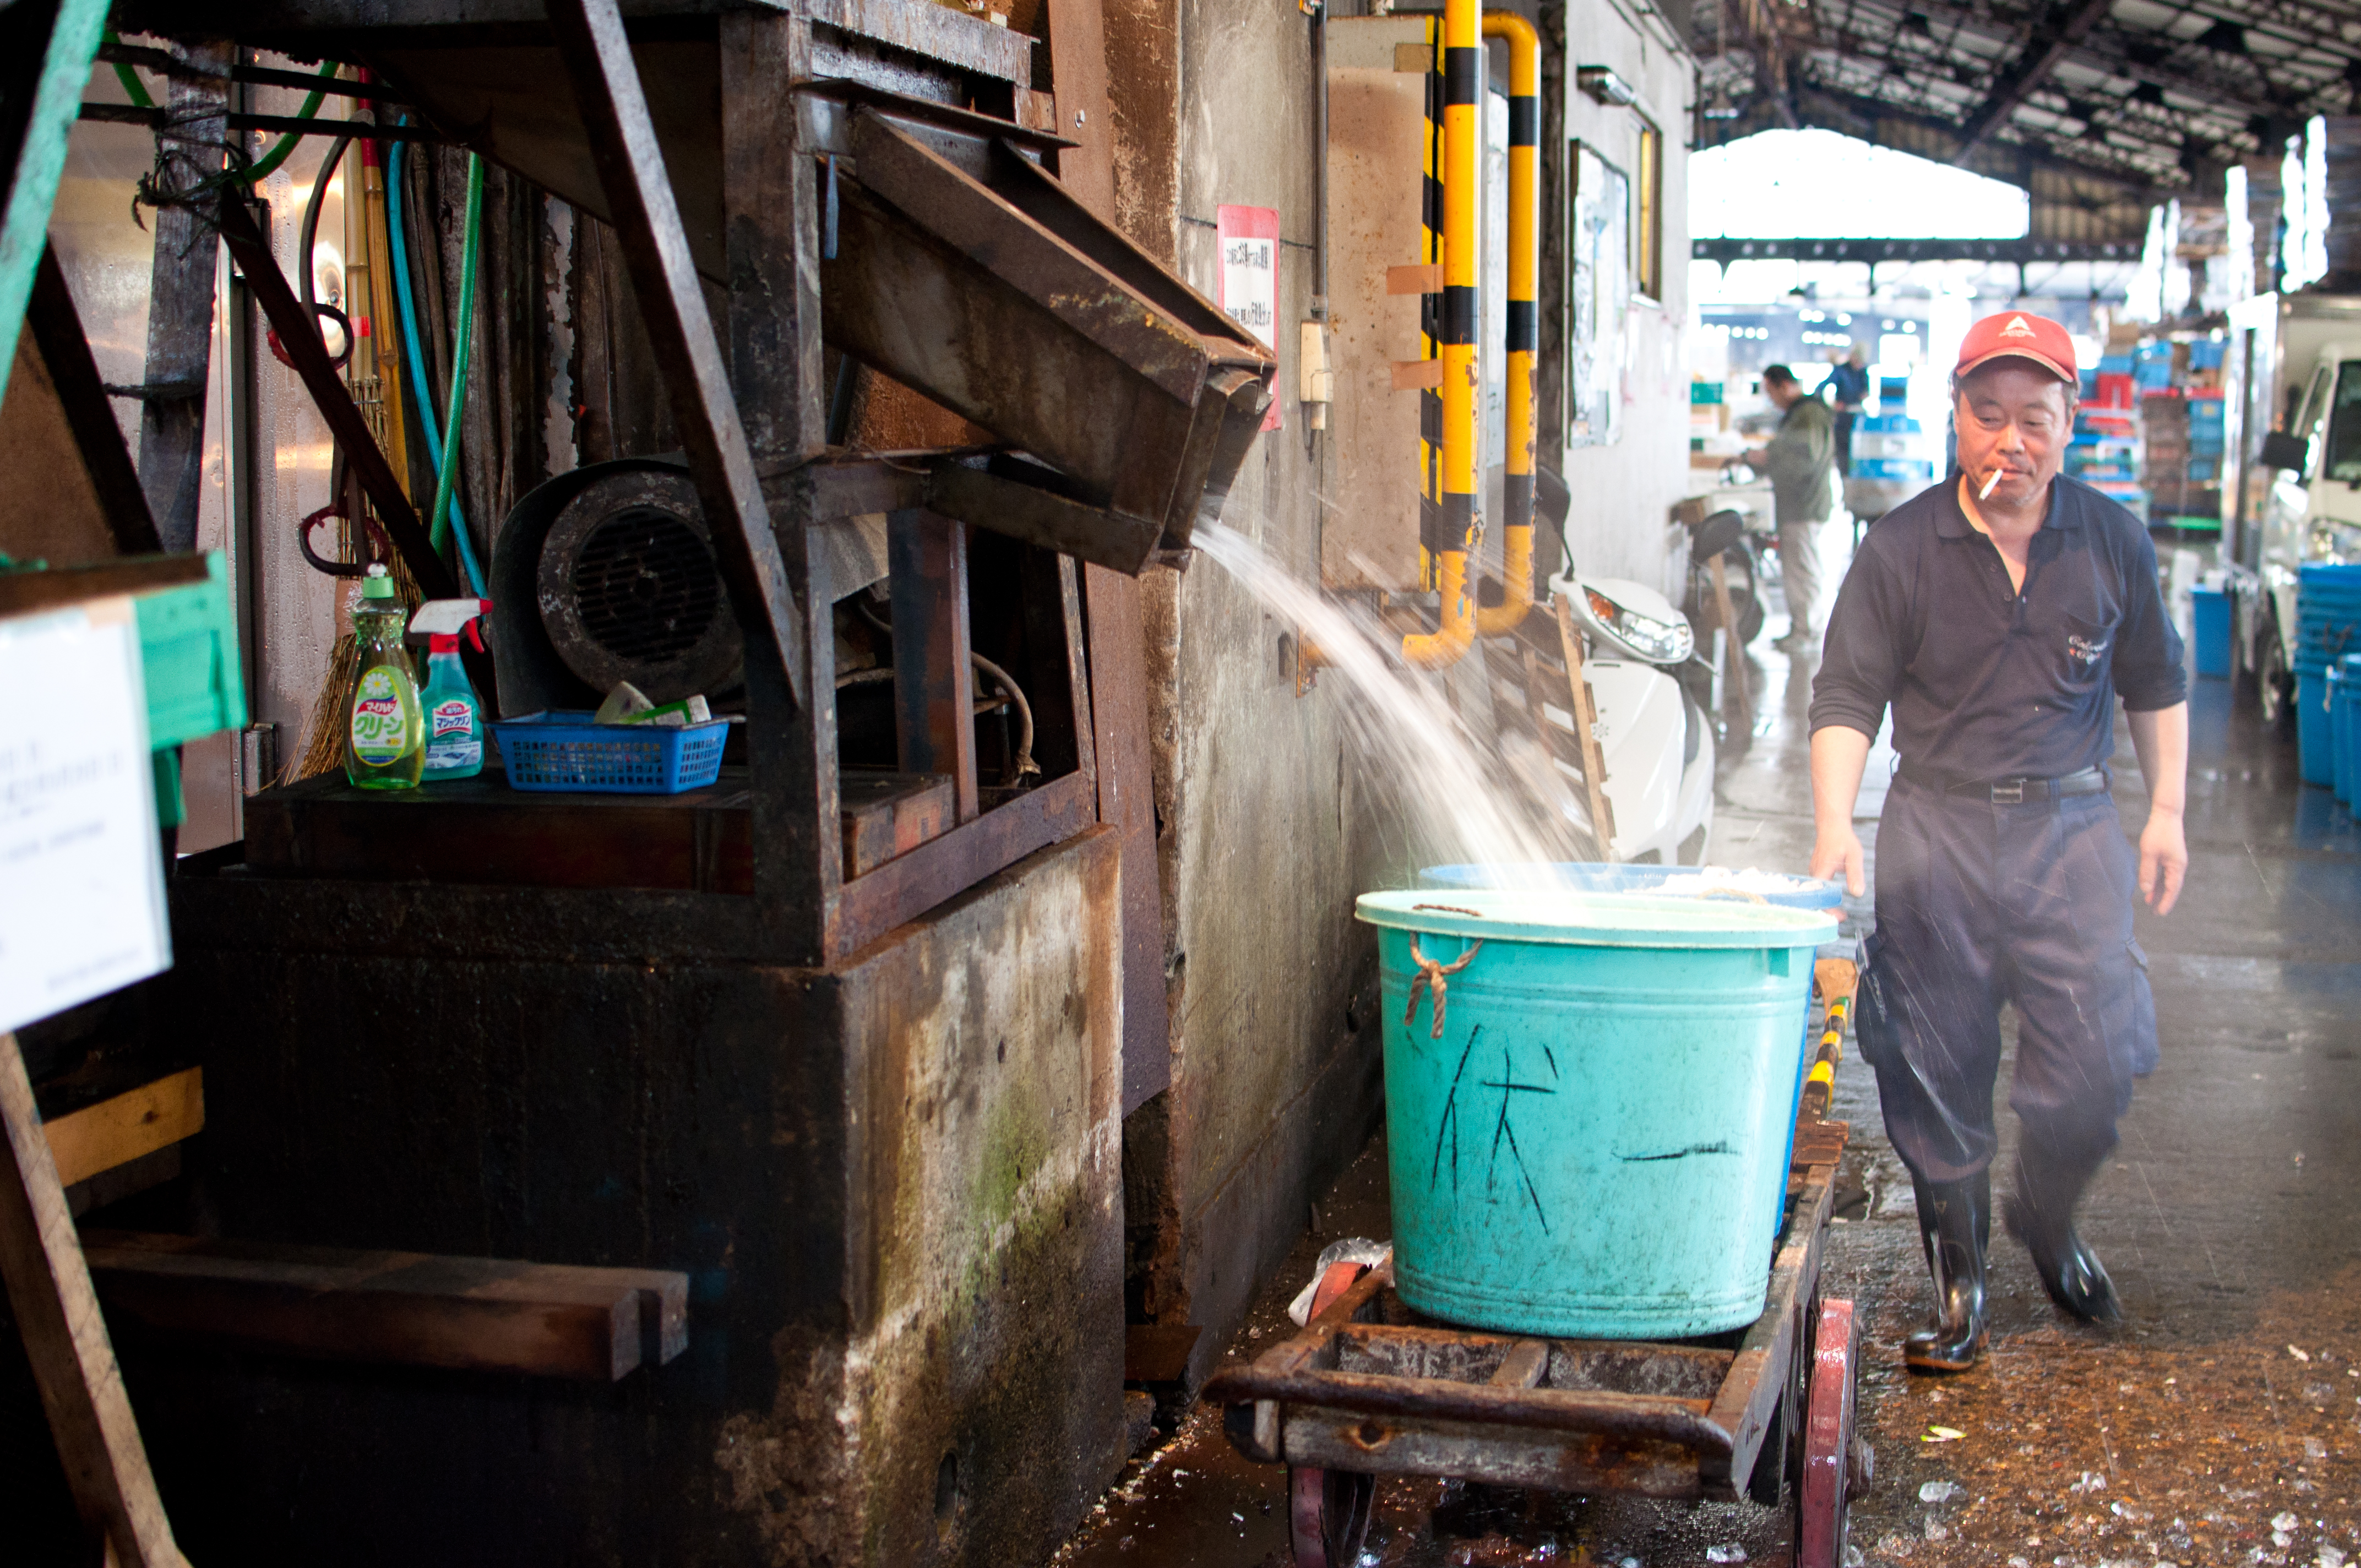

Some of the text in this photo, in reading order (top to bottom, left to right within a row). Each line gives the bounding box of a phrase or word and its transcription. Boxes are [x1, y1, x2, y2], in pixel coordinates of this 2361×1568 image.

[436, 716, 470, 728] マジックリン
